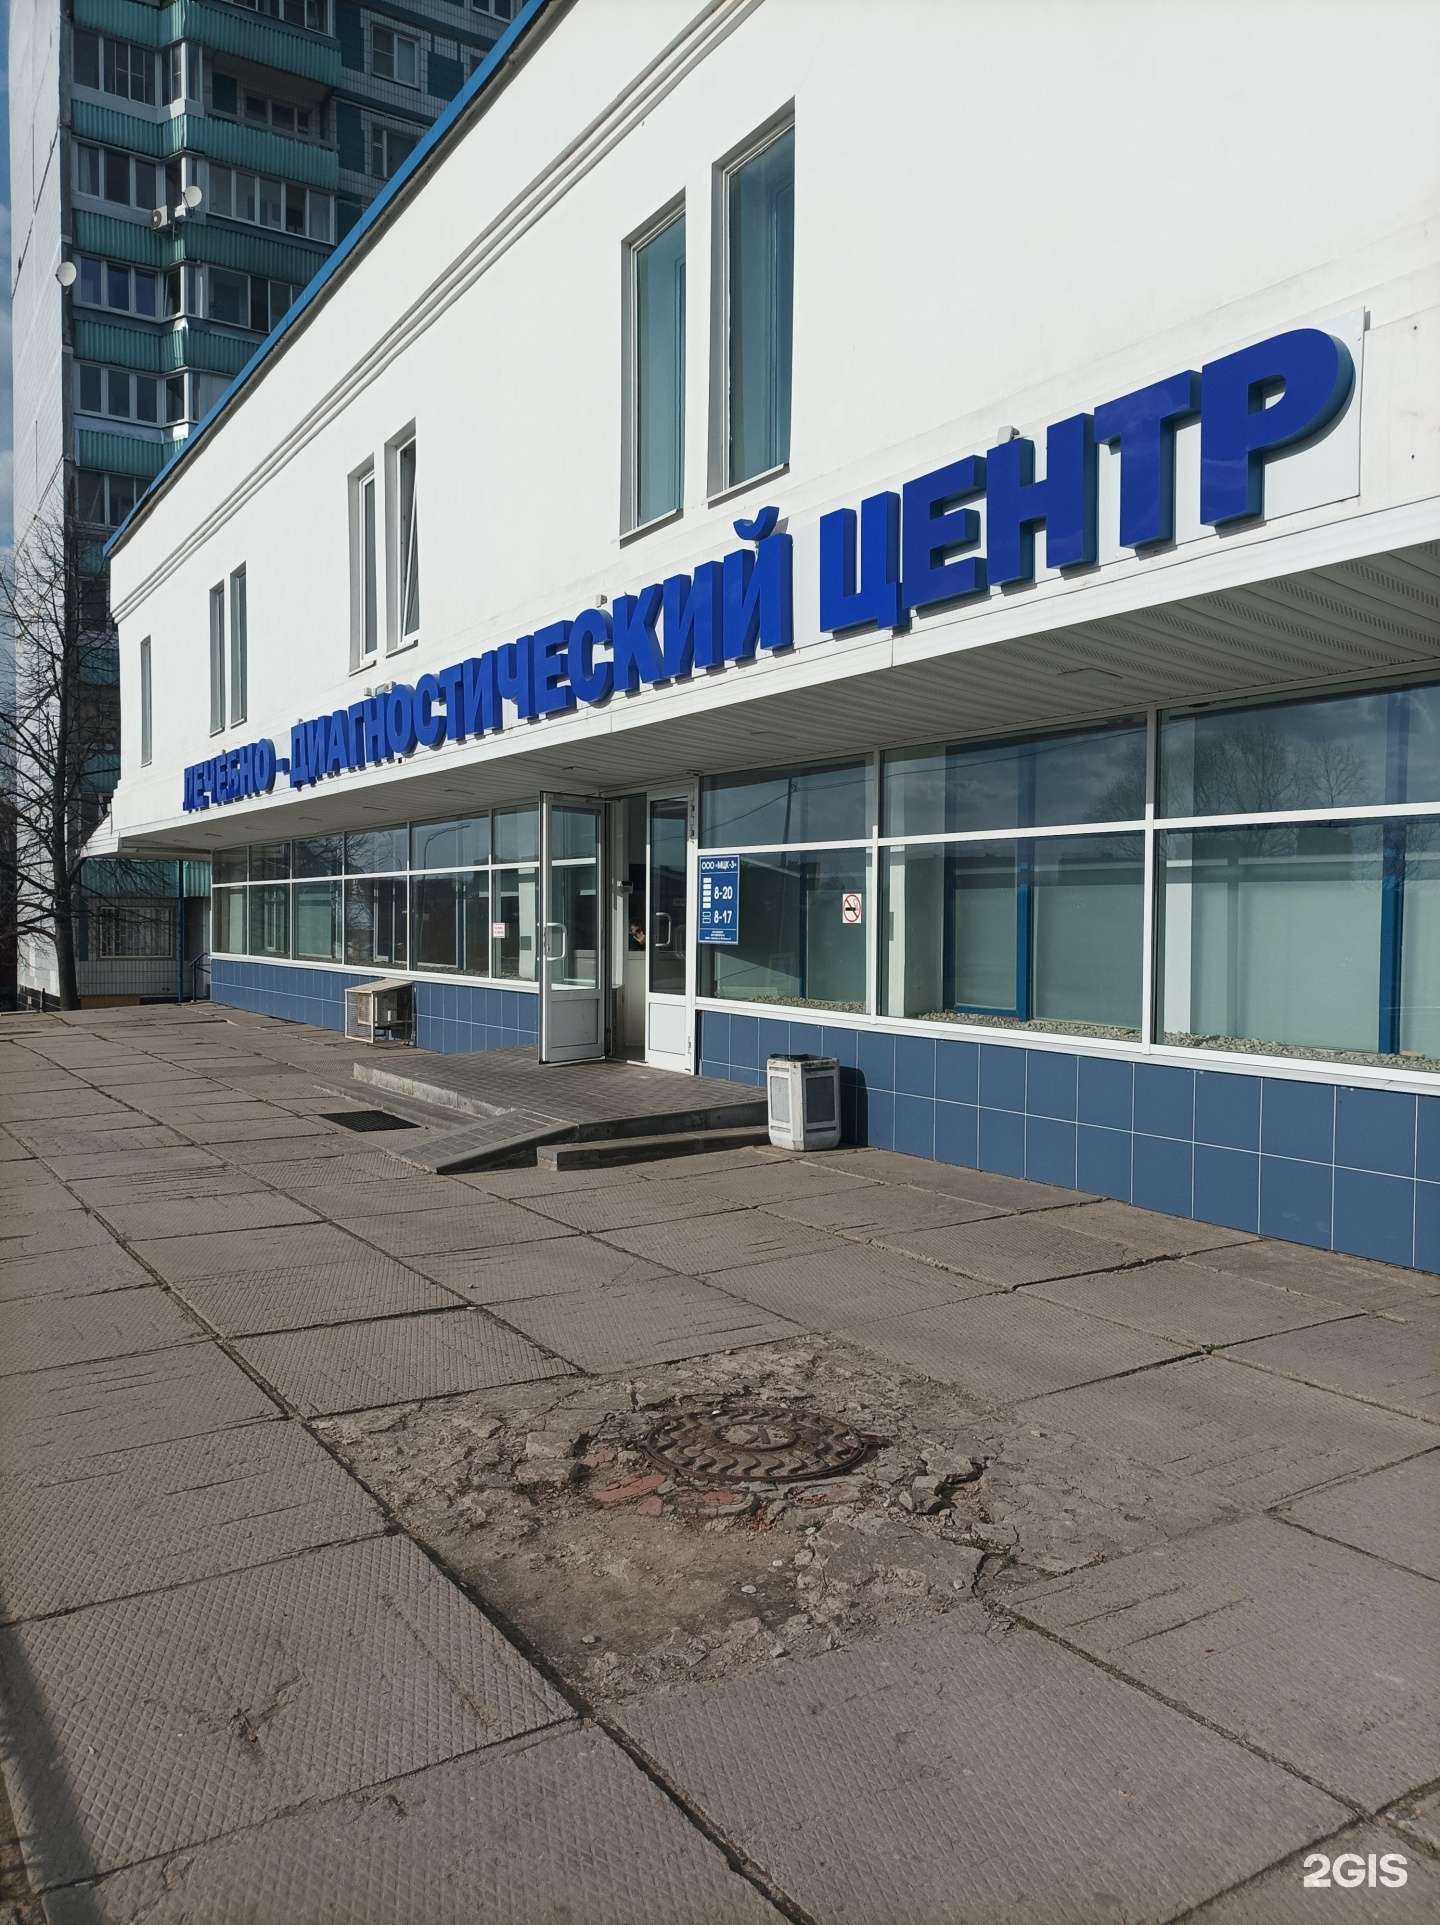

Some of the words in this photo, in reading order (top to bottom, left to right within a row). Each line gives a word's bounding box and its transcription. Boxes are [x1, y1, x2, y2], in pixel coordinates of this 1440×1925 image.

[820, 328, 1355, 633] ЦЕНТР
[701, 861, 714, 870] ООО
[714, 886, 733, 900] 8-20
[713, 910, 733, 924] 8-17
